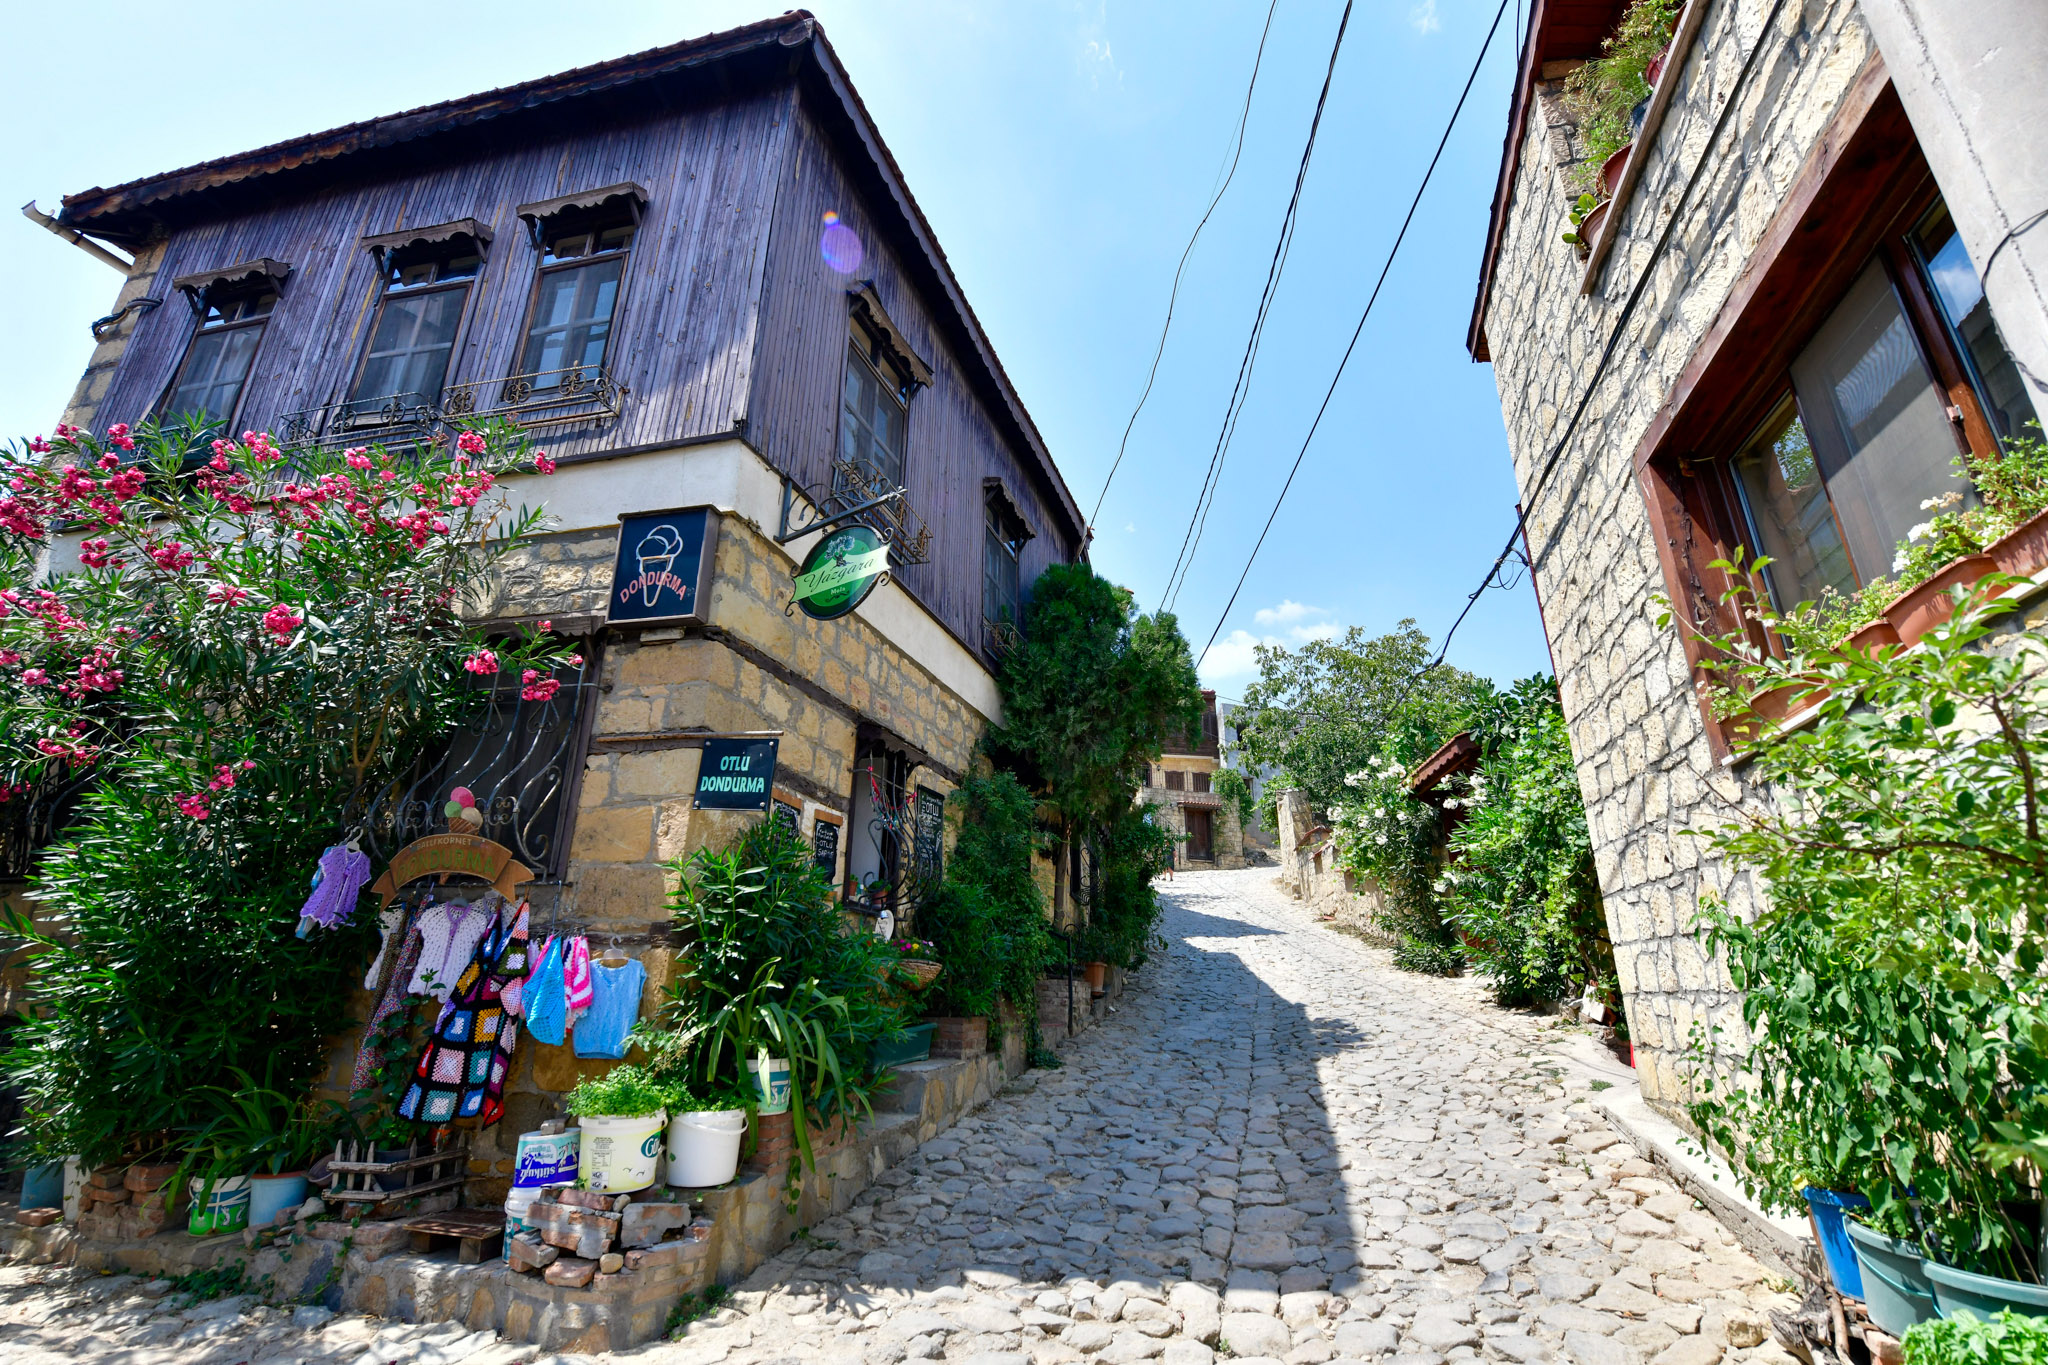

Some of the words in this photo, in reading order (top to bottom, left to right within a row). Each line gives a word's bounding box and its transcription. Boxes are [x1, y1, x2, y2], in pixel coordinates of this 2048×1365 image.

[620, 571, 687, 603] DONDURMA
[804, 558, 874, 592] Yazgara
[720, 755, 751, 771] OTLU
[700, 776, 765, 793] DONDURMA
[437, 836, 472, 846] KORNET
[397, 849, 496, 884] DONDURMA
